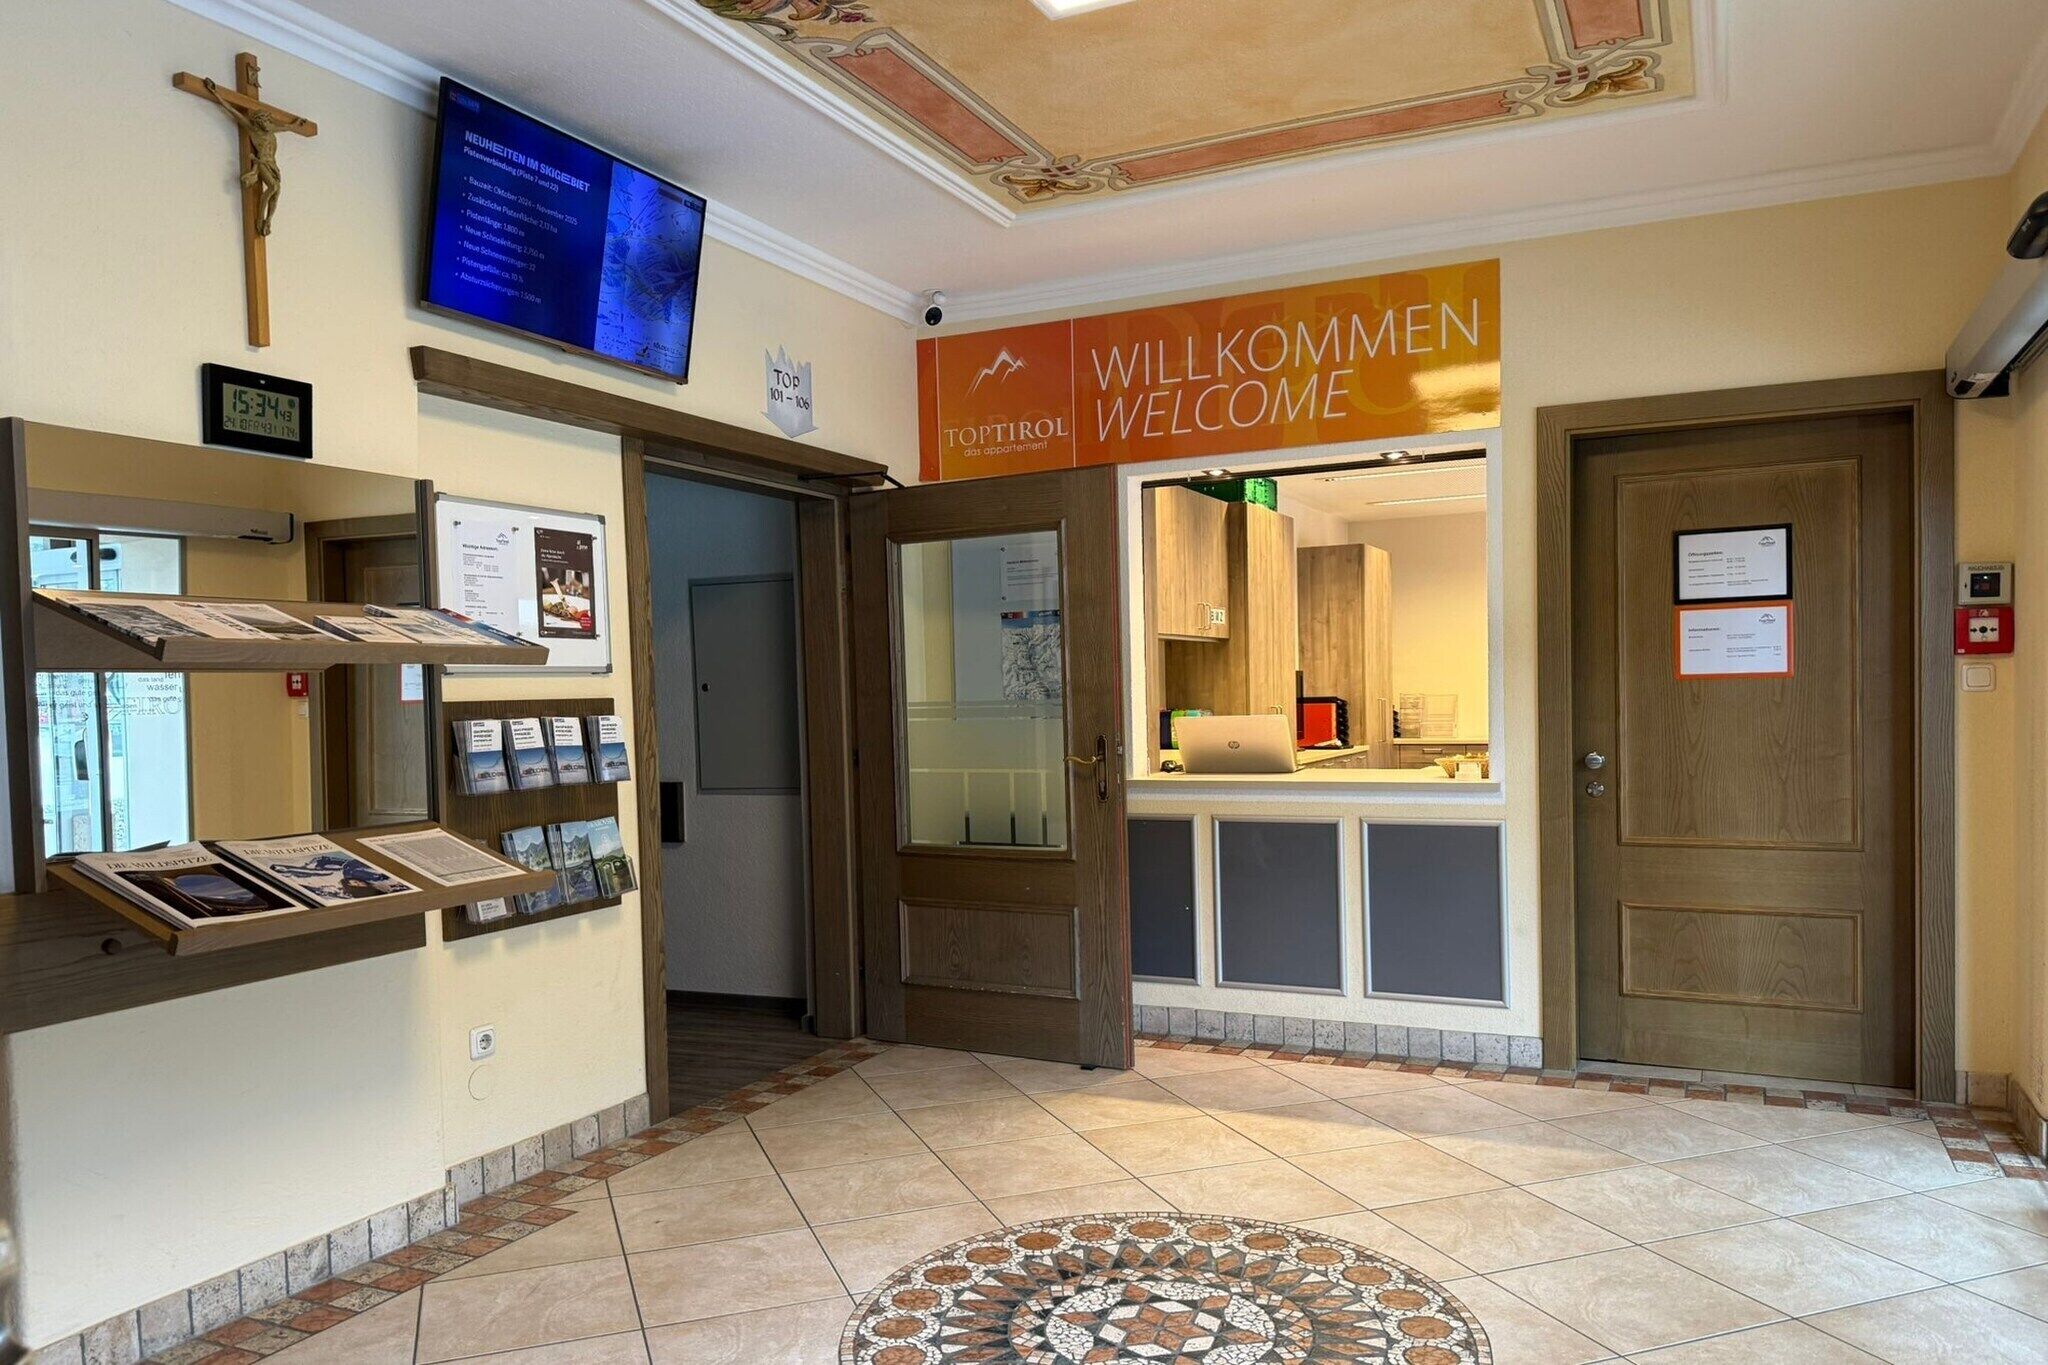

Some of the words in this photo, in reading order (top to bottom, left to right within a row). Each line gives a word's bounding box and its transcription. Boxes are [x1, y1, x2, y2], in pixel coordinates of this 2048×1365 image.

[463, 146, 517, 176] Pistenverbindung
[464, 130, 526, 167] NEUHEITEN
[526, 157, 539, 171] IM
[539, 163, 591, 193] SKIGEBIET
[468, 176, 493, 193] Bauzeit:
[493, 186, 517, 201] Oktober
[536, 203, 565, 220] November
[465, 224, 481, 237] Neue
[463, 240, 480, 253] Neue
[1091, 297, 1480, 392] WILLKOMMEN
[773, 368, 800, 391] TOP
[232, 388, 279, 420] 15:34
[770, 387, 784, 403] 101
[795, 395, 810, 410] 106
[1097, 369, 1355, 443] WELCOME
[280, 410, 292, 422] 43
[944, 416, 1070, 448] TOPTIROL
[964, 446, 984, 458] das
[984, 440, 1049, 457] appartement
